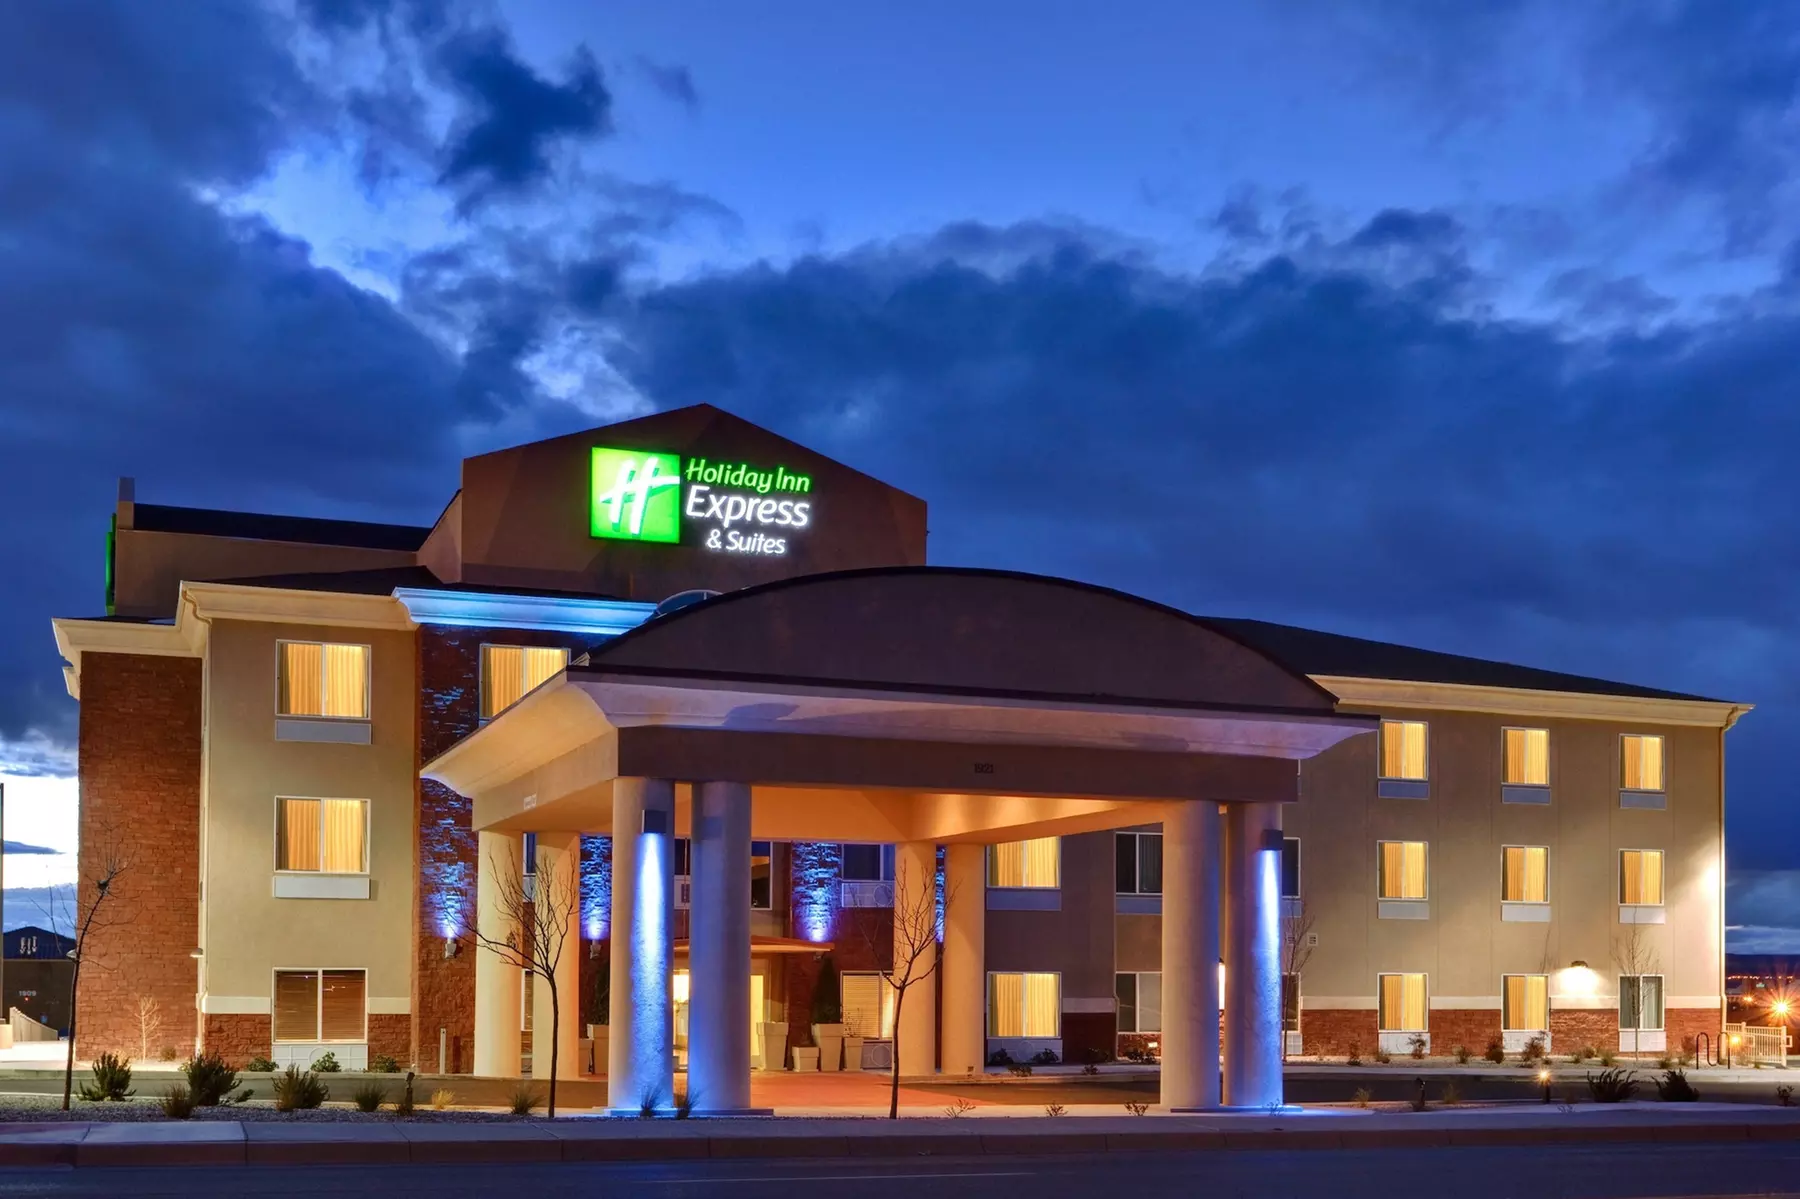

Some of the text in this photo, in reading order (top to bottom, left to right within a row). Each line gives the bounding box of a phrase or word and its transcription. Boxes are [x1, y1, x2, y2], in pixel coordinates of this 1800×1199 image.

[684, 457, 811, 494] Holiday Inn
[685, 484, 811, 529] Express
[706, 528, 787, 555] & Suites
